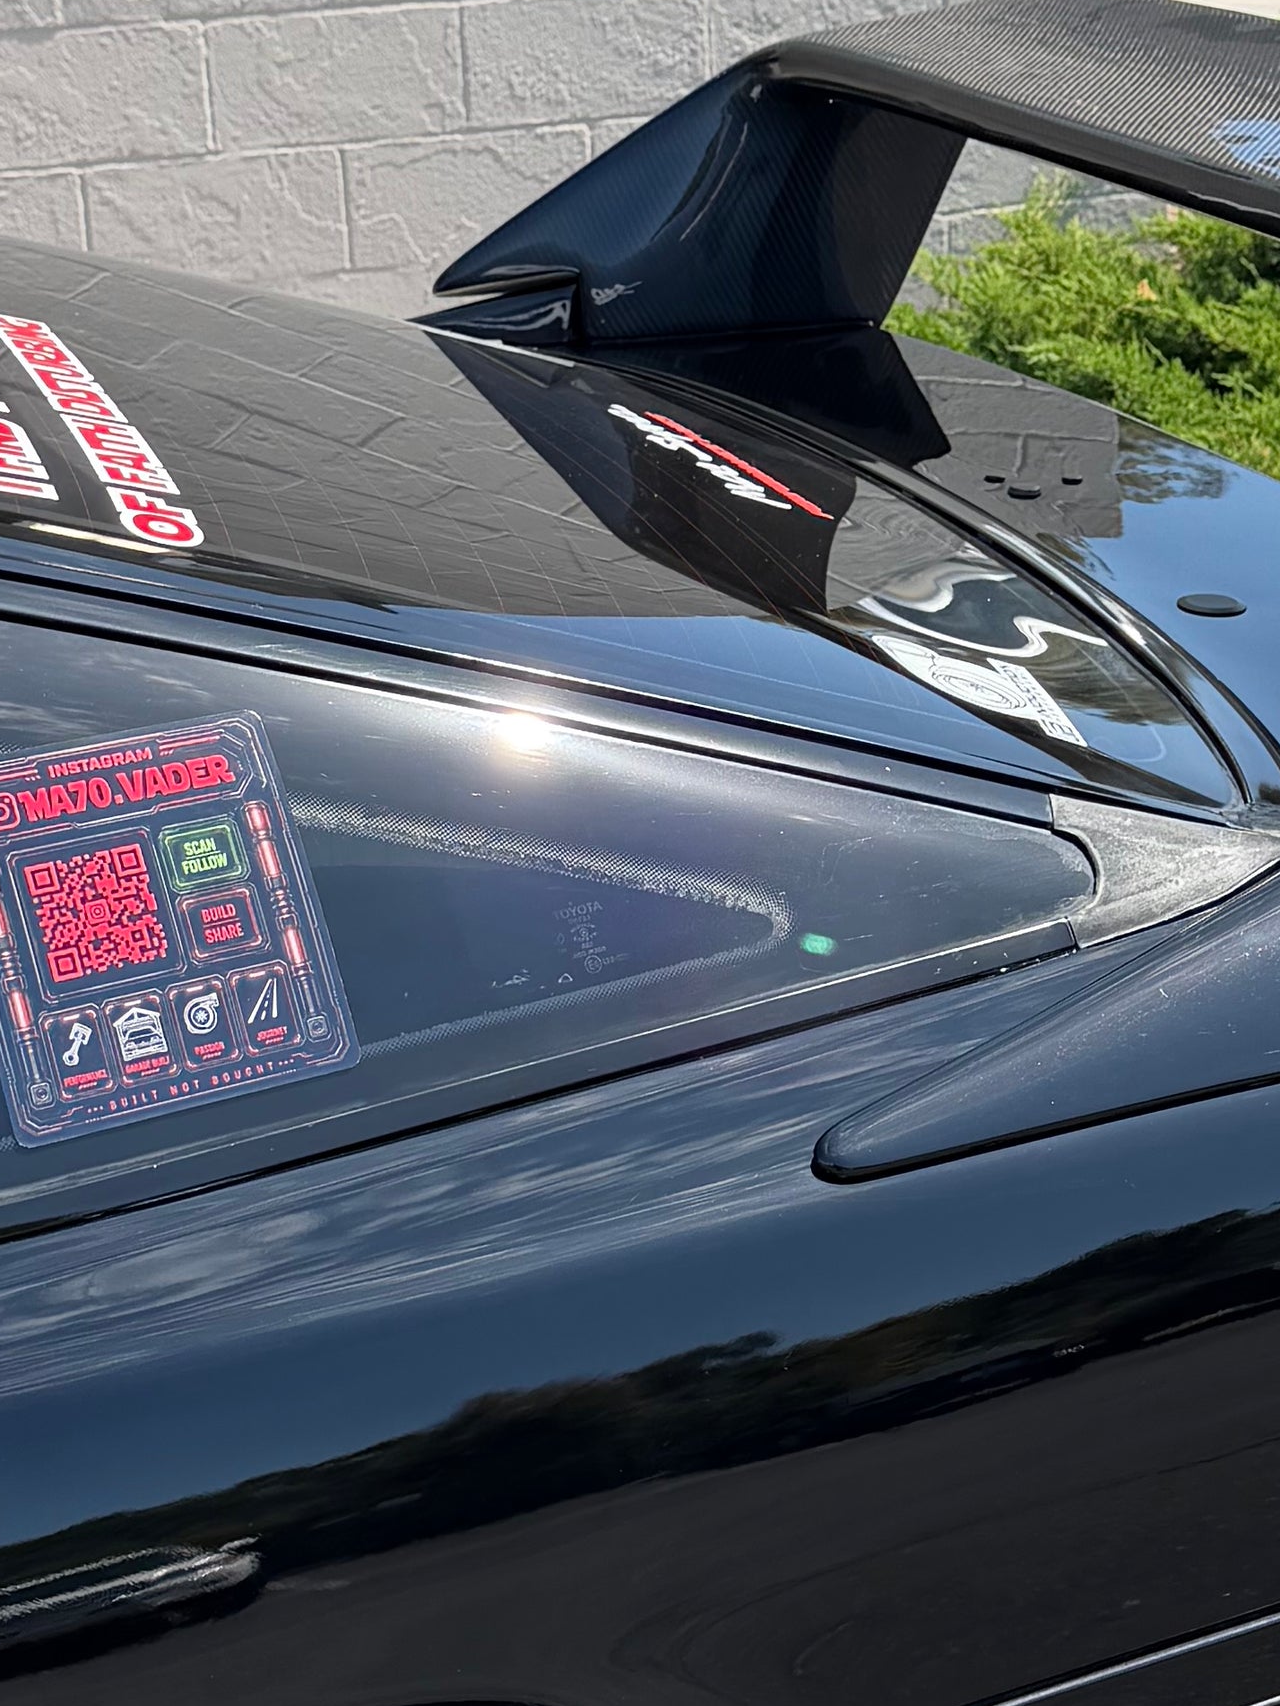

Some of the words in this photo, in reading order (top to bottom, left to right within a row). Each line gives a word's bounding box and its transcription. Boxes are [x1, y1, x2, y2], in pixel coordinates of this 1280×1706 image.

[58, 412, 180, 494] FAITH
[118, 487, 204, 547] OF
[47, 747, 153, 777] INSTAGRAM
[15, 753, 237, 822] MA70.VADER
[182, 837, 217, 856] SCAN
[181, 852, 229, 875] FOLLOW
[200, 903, 236, 923] BUILD
[204, 923, 245, 944] SHARE
[108, 1089, 160, 1112] BUILT
[168, 1079, 202, 1096] NOT
[211, 1060, 275, 1086] BOUGHT
